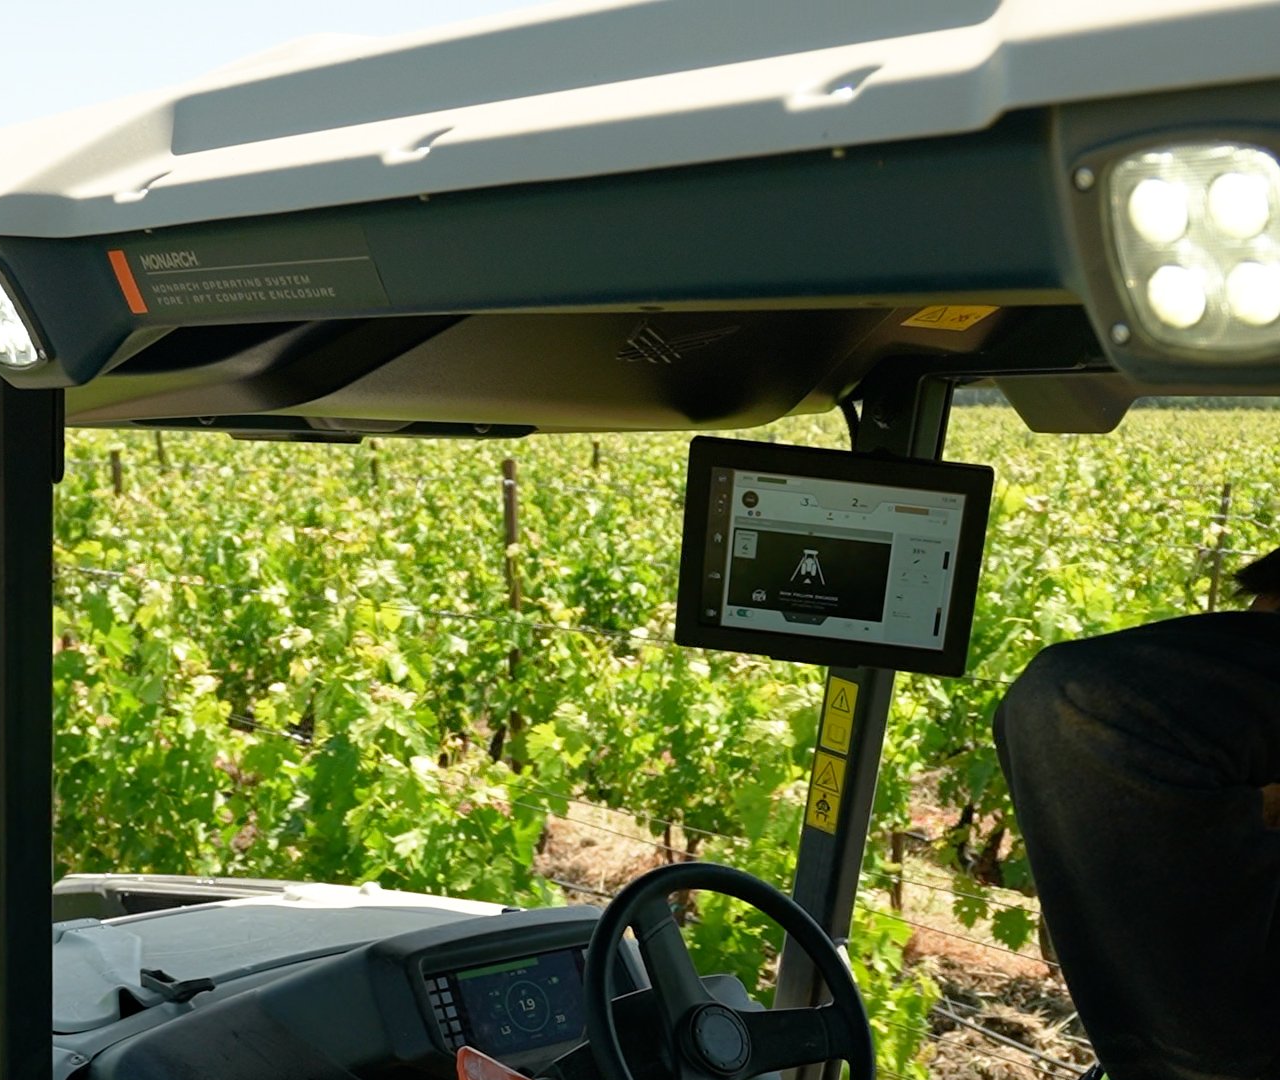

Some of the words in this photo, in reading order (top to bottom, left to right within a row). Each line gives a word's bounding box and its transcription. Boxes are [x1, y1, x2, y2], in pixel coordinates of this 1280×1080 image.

[140, 250, 199, 270] MONARCH
[152, 281, 200, 294] MONARCH
[201, 277, 262, 291] OPERATING
[263, 274, 311, 287] SYSTEM
[156, 294, 183, 306] FORE
[193, 293, 212, 304] AFT
[216, 289, 267, 303] COMPUTE
[269, 286, 336, 301] ENCLOSURE
[851, 498, 859, 507] 2
